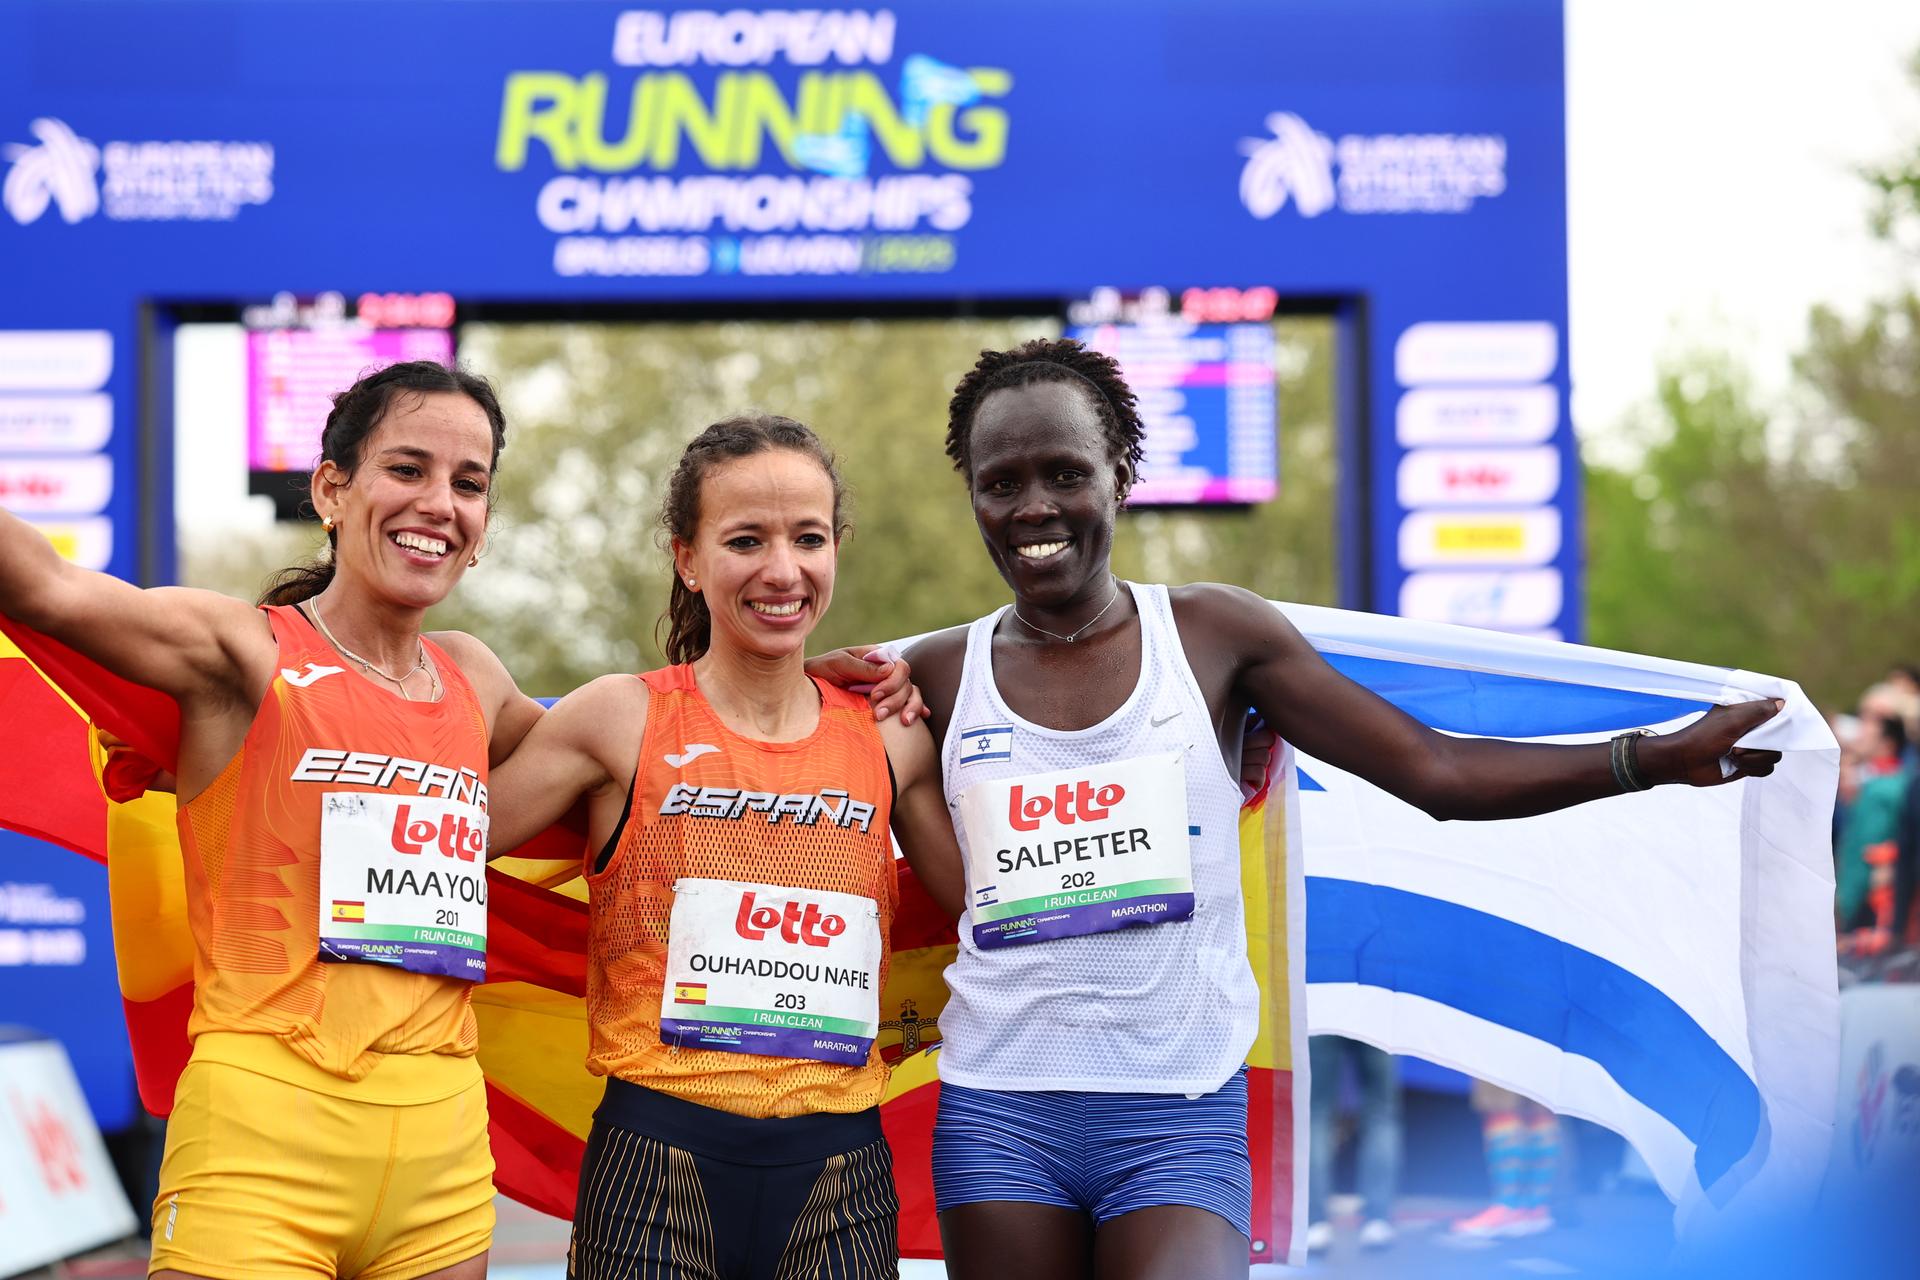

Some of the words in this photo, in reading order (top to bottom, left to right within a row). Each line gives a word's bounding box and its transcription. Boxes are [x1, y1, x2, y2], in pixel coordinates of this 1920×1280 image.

[613, 10, 896, 65] EUROPEAN
[496, 69, 1013, 171] RUNNING
[537, 174, 973, 232] CHAMPIONSHIPS
[658, 783, 876, 833] ESPAÑA
[996, 828, 1151, 873] SALPETER
[1061, 872, 1096, 889] 202
[1044, 898, 1049, 908] I
[1050, 895, 1076, 908] RUN
[1079, 889, 1117, 904] CLEAN
[435, 910, 459, 927] 201
[1111, 903, 1168, 918] MARATHON
[1000, 917, 1036, 933] RUNNING
[414, 930, 420, 940] I
[420, 930, 446, 942] RUN
[447, 933, 473, 946] CLEAN
[361, 944, 403, 956] RUNNING
[690, 954, 819, 982] OUHADDOU
[825, 966, 869, 990] NAFIE
[774, 993, 806, 1010] 203
[753, 1012, 758, 1023] I
[759, 1012, 786, 1026] RUN
[787, 1015, 823, 1029] CLEAN
[701, 1025, 742, 1037] RUNNING
[813, 1039, 858, 1053] MARATHON
